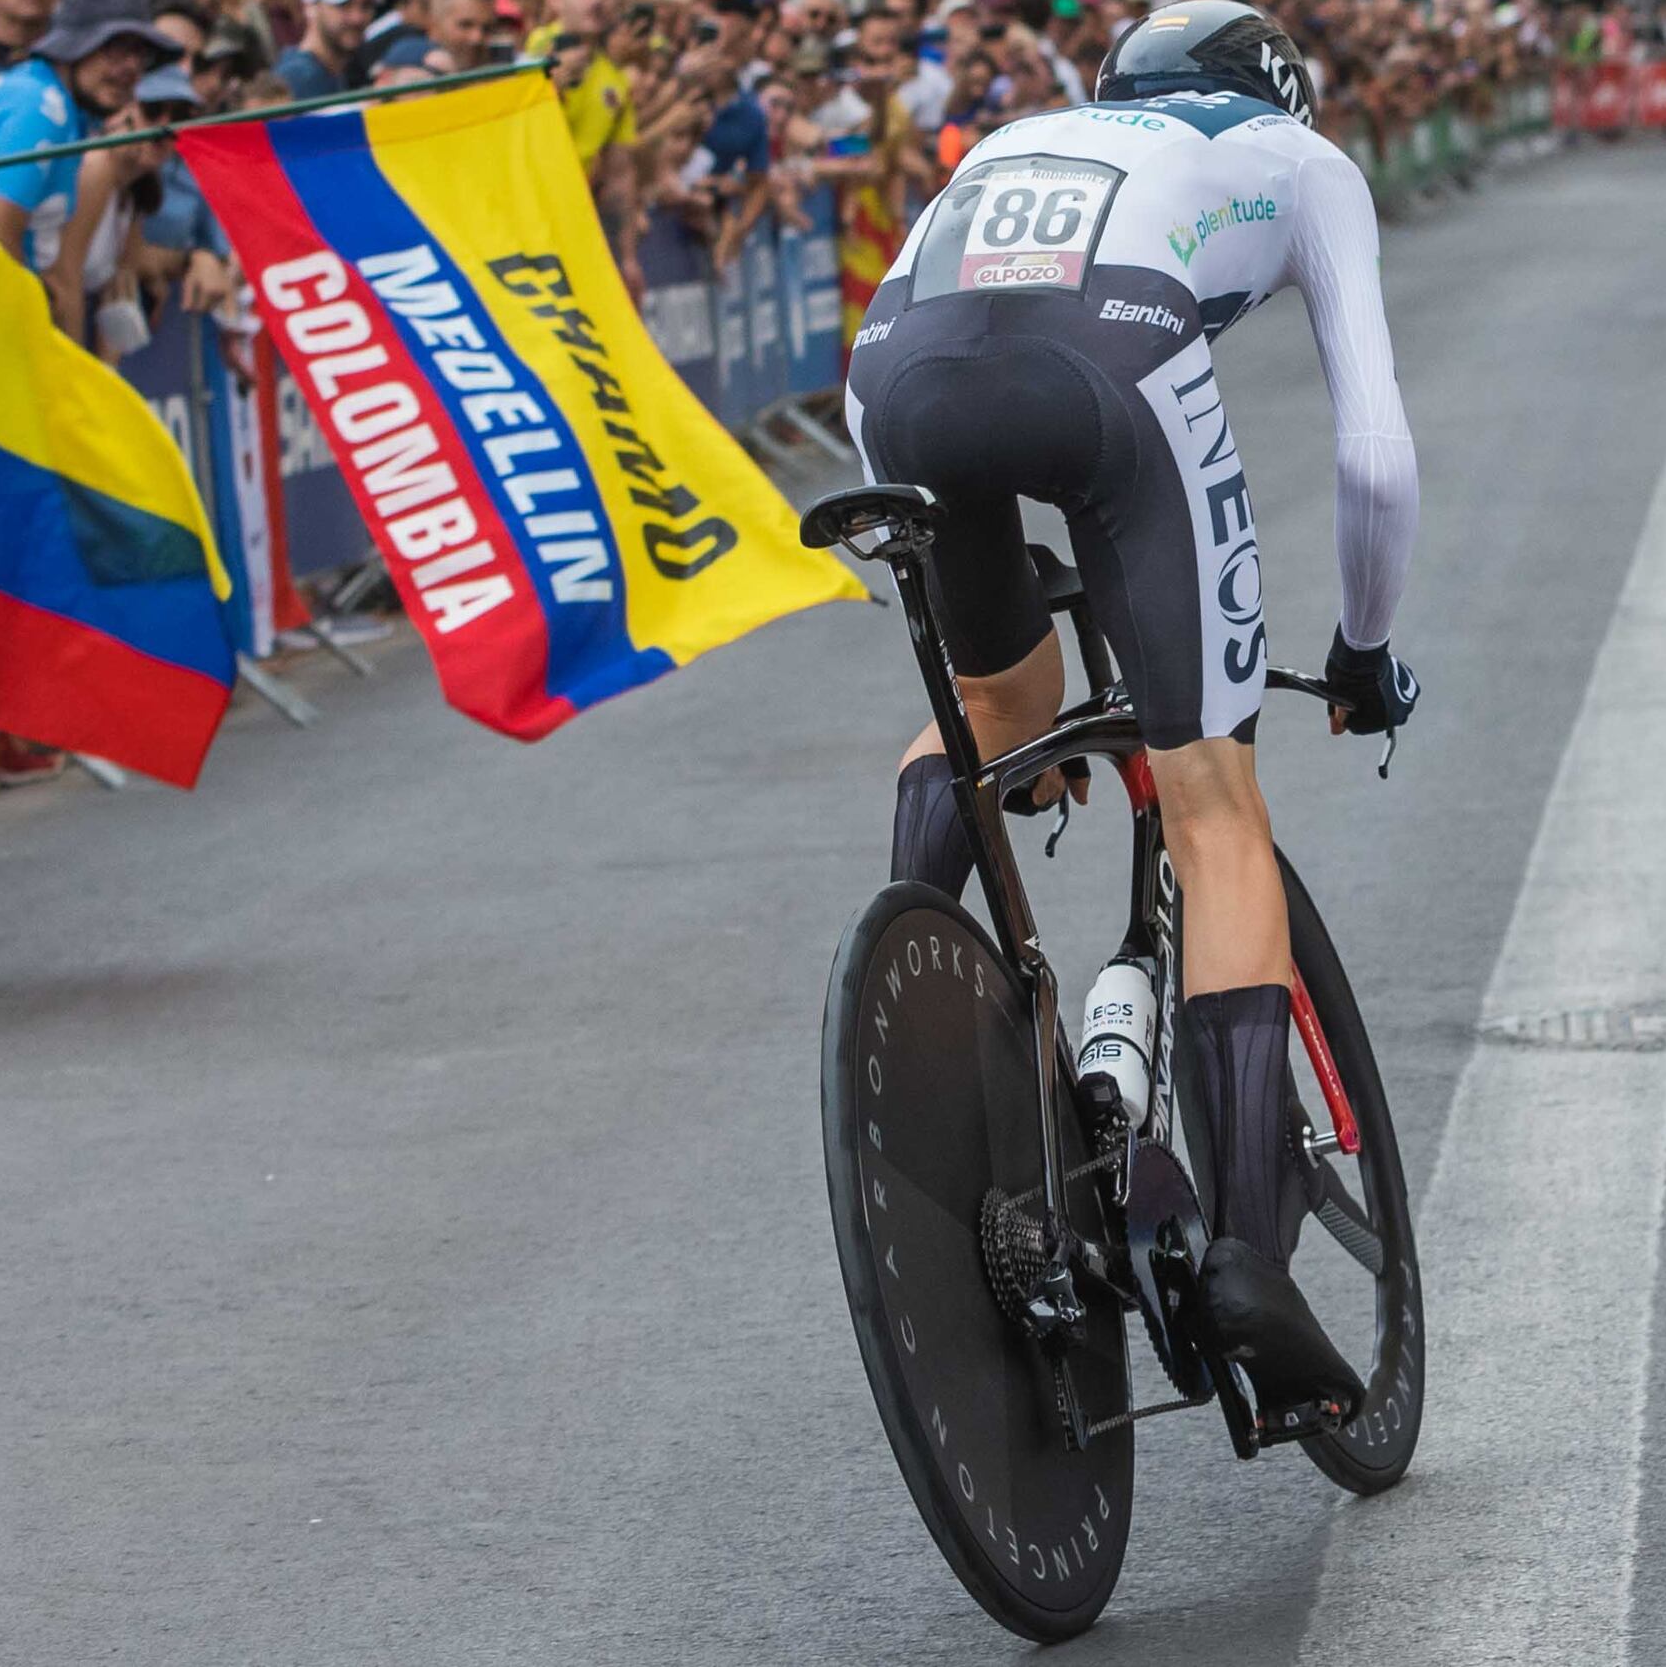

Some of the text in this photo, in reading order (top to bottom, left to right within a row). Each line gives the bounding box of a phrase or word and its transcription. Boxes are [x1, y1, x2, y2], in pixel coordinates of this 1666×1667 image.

[983, 188, 1087, 248] 86
[1196, 191, 1277, 247] plenitude
[1098, 298, 1186, 336] Santini
[259, 250, 515, 635] COLOMBIA
[356, 244, 614, 605] MEDELLIN
[1170, 366, 1268, 686] INEOS
[1085, 1002, 1134, 1024] EOS
[932, 1405, 1111, 1582] PRINCETON
